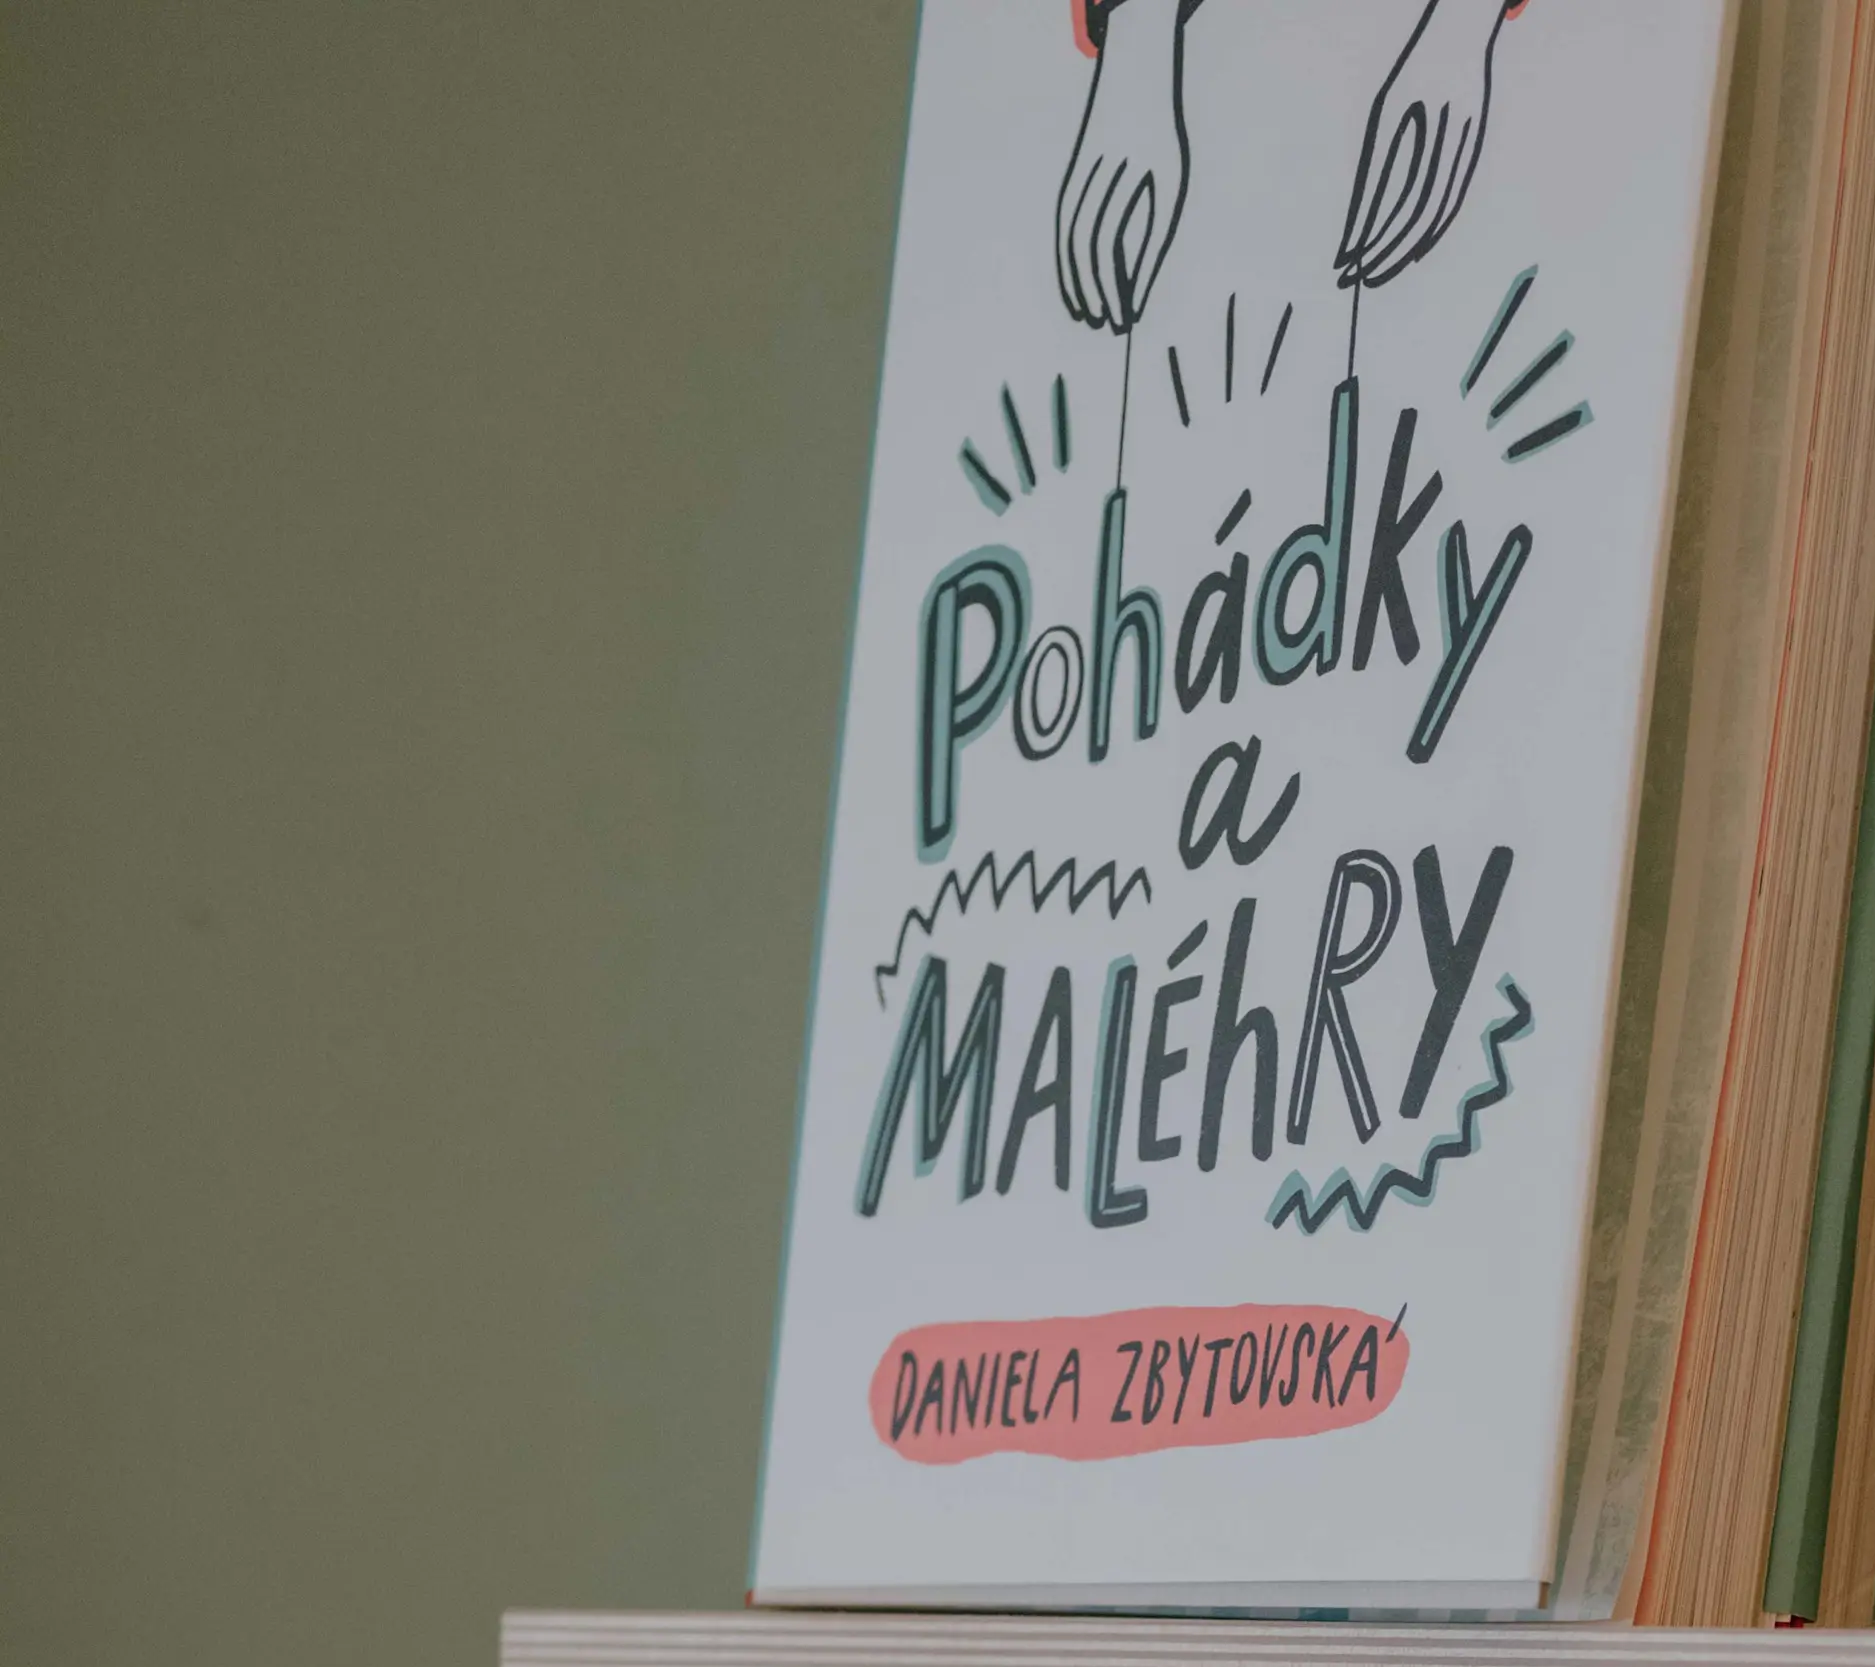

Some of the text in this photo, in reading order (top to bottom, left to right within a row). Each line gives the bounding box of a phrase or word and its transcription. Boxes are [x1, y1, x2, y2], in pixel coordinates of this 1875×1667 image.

[918, 376, 1532, 862] Pohádky
[1178, 734, 1301, 870] a
[890, 1302, 1409, 1443] DANIELA ZBYTOVSKÁ
